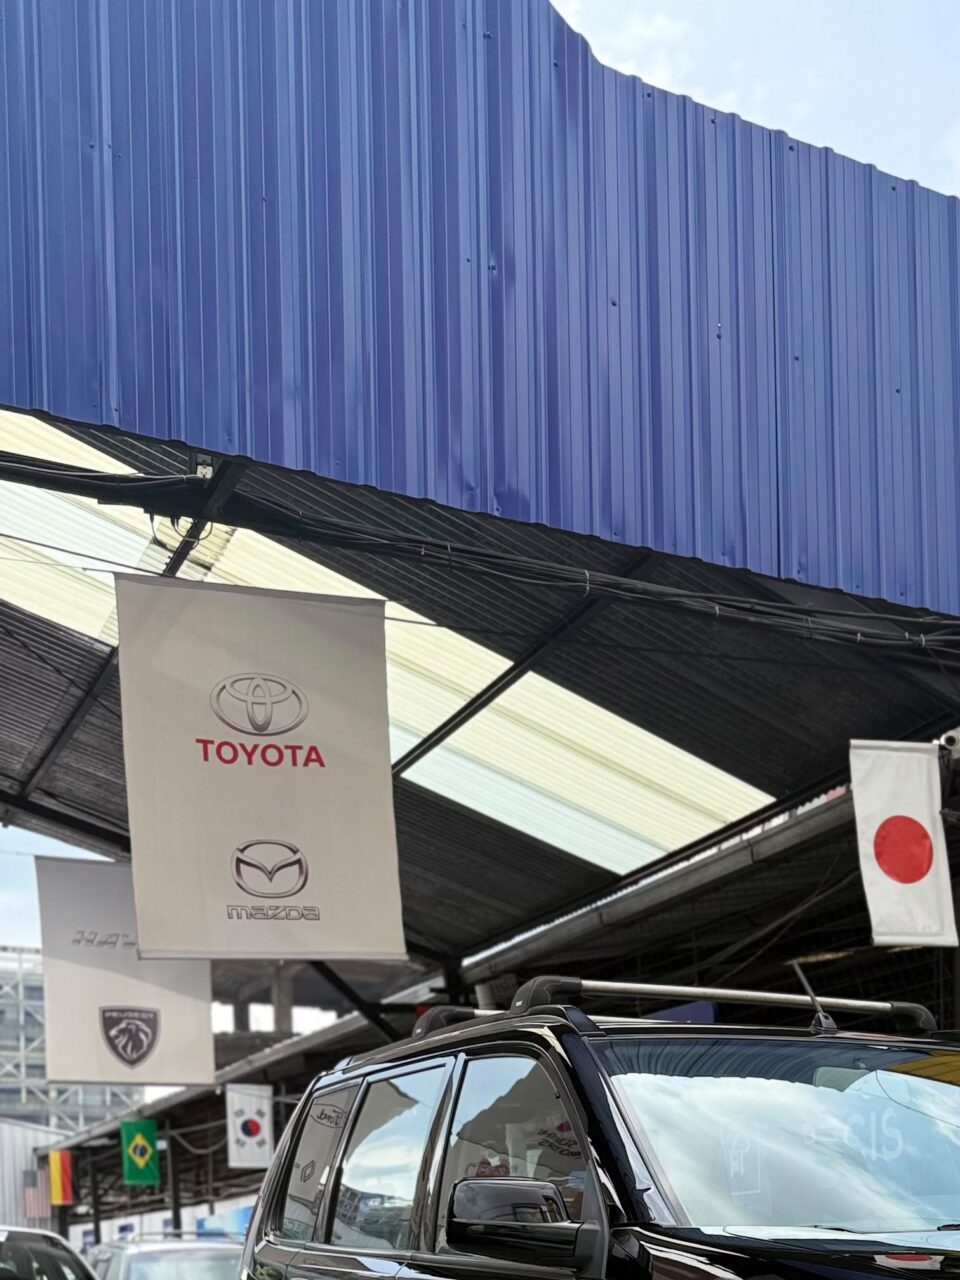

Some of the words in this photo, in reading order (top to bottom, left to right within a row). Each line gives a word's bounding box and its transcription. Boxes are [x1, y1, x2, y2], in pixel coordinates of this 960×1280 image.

[195, 738, 326, 768] TOYOTA
[72, 930, 138, 950] HAV
[104, 1011, 155, 1020] PEUGEOT
